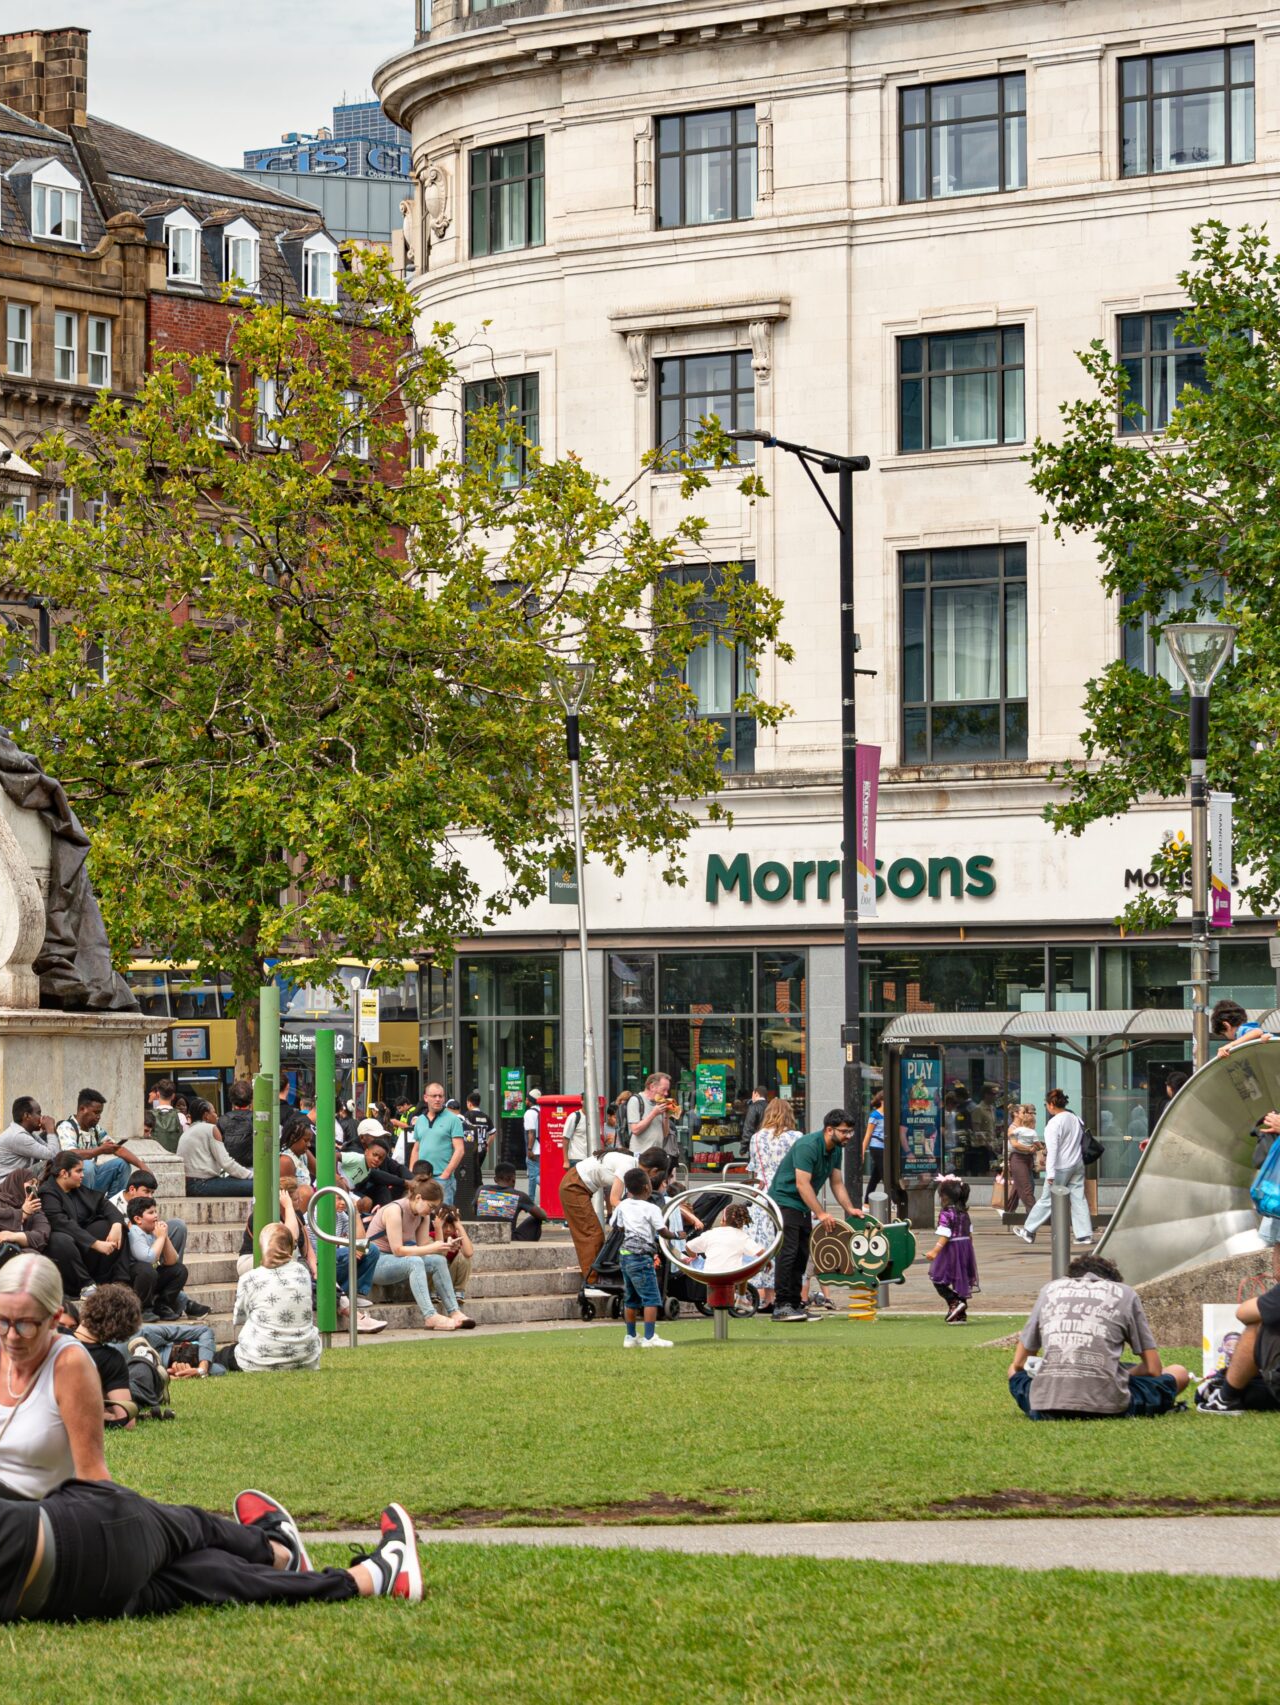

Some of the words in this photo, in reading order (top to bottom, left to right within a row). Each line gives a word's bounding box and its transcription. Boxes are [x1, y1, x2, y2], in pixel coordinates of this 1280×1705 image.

[705, 853, 997, 903] Morrons
[907, 1062, 933, 1080] PLAY
[1061, 1319, 1072, 1332] TO
